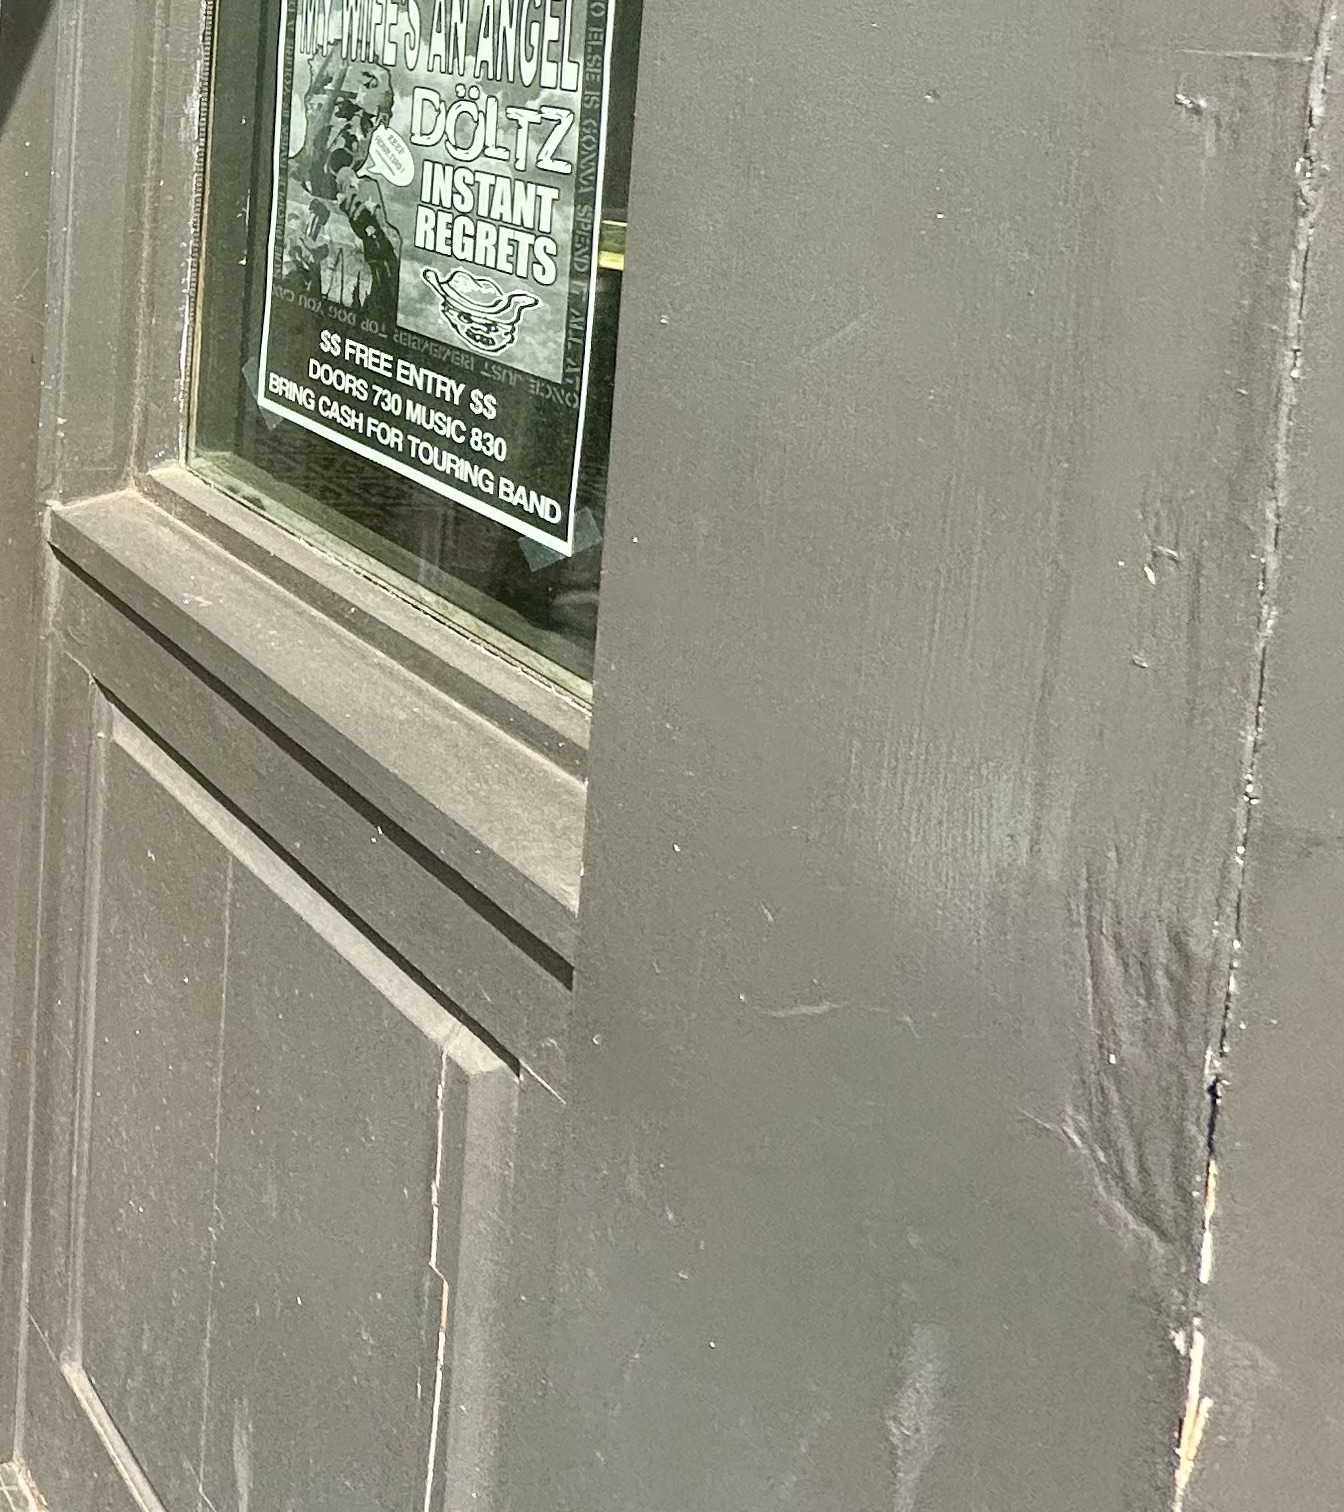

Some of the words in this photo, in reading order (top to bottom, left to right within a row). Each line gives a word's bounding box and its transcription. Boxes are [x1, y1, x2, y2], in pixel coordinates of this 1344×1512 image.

[410, 84, 573, 175] DÖLTZ
[420, 160, 559, 233] INSTANT
[414, 208, 557, 286] REGRETS
[308, 358, 368, 401] DOORS
[371, 385, 402, 416] 730
[404, 399, 467, 444] MUSIC
[469, 427, 508, 463] 830
[319, 330, 342, 356] $$
[344, 339, 393, 378] FREE
[396, 359, 465, 406] ENTRY
[469, 388, 498, 421] $$
[268, 373, 316, 412] BRING
[318, 395, 364, 434] CASH
[367, 416, 404, 453] FOR
[407, 434, 494, 495] TOURING
[497, 476, 562, 525] BAND
